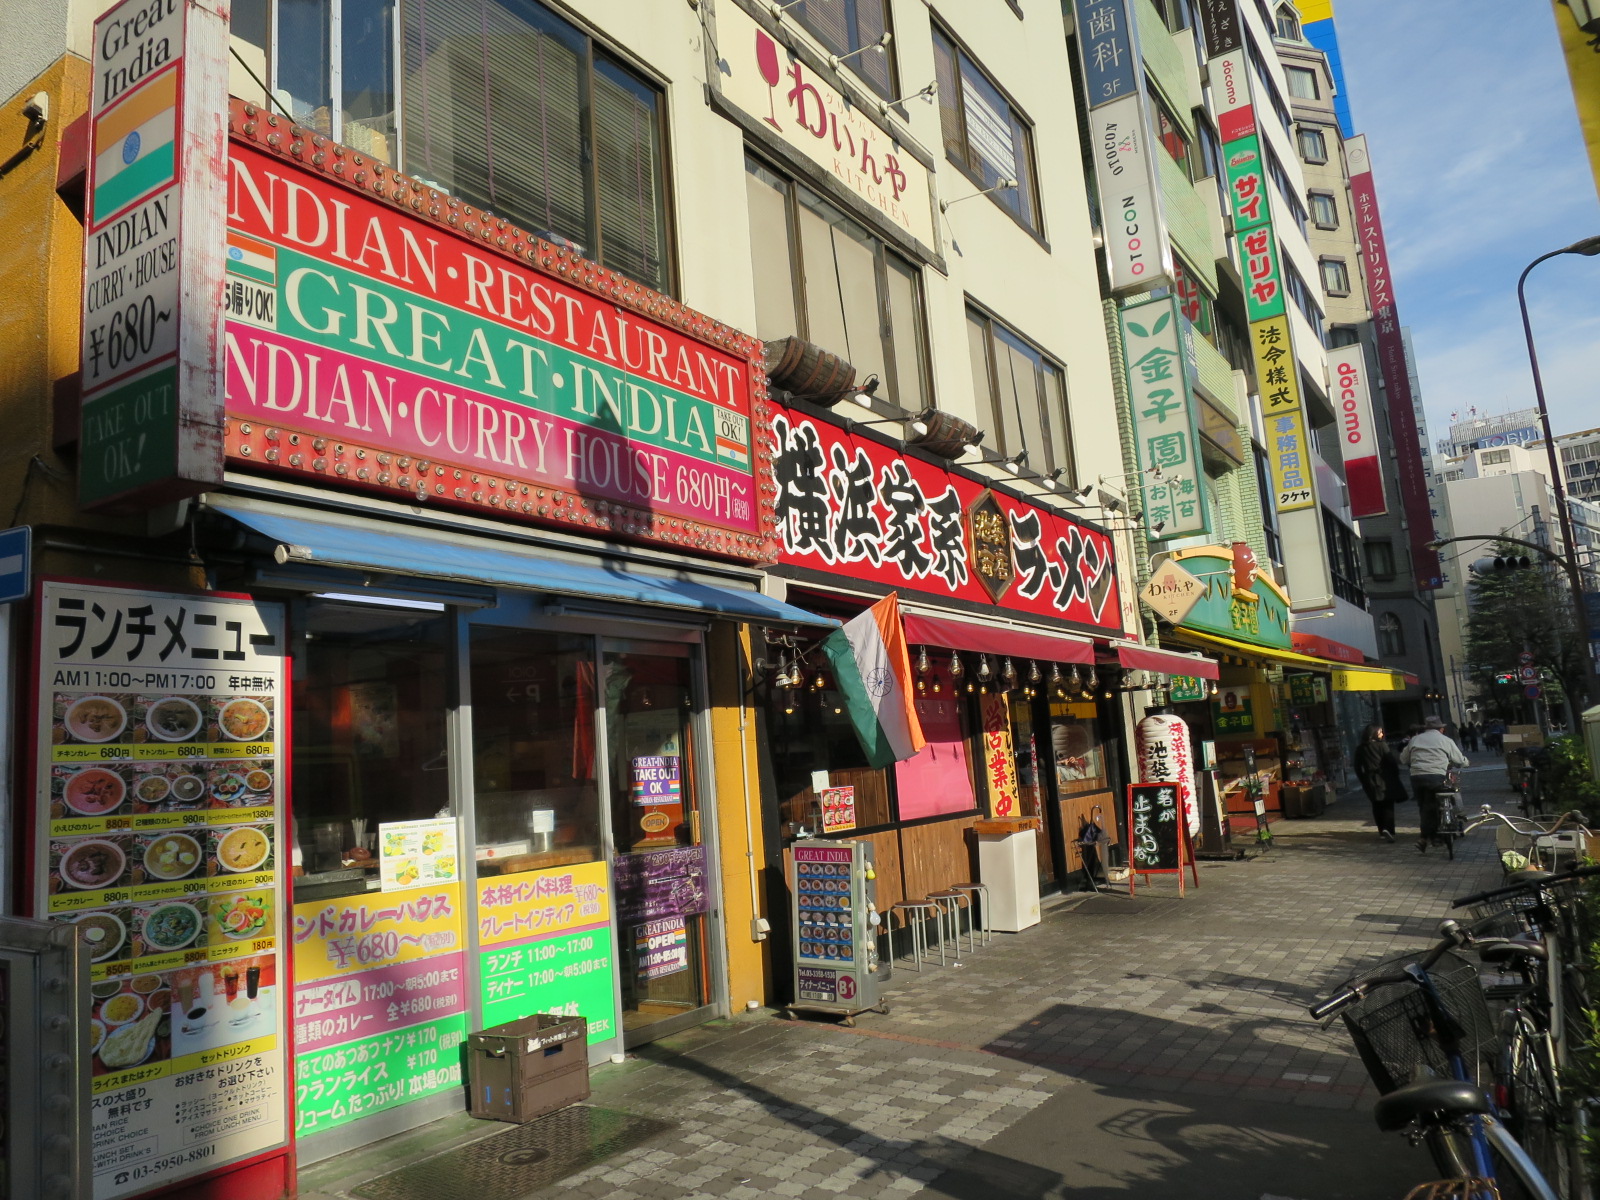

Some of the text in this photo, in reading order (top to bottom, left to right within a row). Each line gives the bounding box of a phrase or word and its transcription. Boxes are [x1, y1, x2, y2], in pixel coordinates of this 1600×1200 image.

[102, 0, 177, 60] Great
[1085, 0, 1123, 72] 歯科
[101, 34, 171, 107] India
[1103, 78, 1121, 97] 3F
[1222, 60, 1236, 105] docomo
[786, 60, 907, 202] わいんや
[1105, 123, 1124, 176] OTOCON
[833, 158, 910, 228] KITCHEN
[96, 195, 170, 269] INDIAN
[1121, 195, 1145, 275] OTOCON
[1235, 174, 1277, 304] サイゼリヤ
[229, 156, 740, 407] NDIAN RESTAURANT
[225, 281, 274, 323] ち帰りOK!
[285, 267, 714, 455] GREAT INDIA
[225, 332, 396, 438] NDIAN
[84, 383, 172, 447] TAKE OUT
[715, 408, 744, 427] TAKE OUT
[1130, 346, 1187, 469] 金子園
[1337, 362, 1362, 444] docomo
[721, 421, 741, 442] OK!
[1481, 429, 1531, 449] TOBU
[102, 434, 146, 484] OK!
[1274, 414, 1304, 489] 事務用品
[1280, 490, 1310, 504] タケヤ
[771, 414, 1114, 623] 横浜家系 ラーメン
[1148, 580, 1194, 597] わいんや
[55, 597, 276, 663] ランチメニュー
[1168, 609, 1179, 617] 2F
[228, 675, 275, 692] 年中無休
[245, 745, 270, 755] 680円
[1147, 740, 1171, 782] 池袋
[633, 767, 677, 781] TAKE OUT
[649, 781, 663, 794] OK
[798, 850, 849, 862] GREAT INDIA
[481, 874, 573, 908] 本格インド料理
[294, 894, 453, 943] ンドカレーハウス
[479, 903, 575, 938] グレートインディア
[211, 940, 273, 957] ミニサラダ 180円
[648, 933, 676, 949] OPEN
[486, 949, 523, 973] ランチ
[296, 984, 358, 1015] ナータイム
[486, 976, 524, 999] ディナー
[799, 979, 836, 991] ディナーメニュー
[295, 1013, 374, 1046] 種類のカレー
[586, 1018, 610, 1036] EEK
[200, 1044, 251, 1064] セットドリンク
[297, 1034, 405, 1081] たてのあつあつナン
[175, 1056, 262, 1088] お好きなドリンクを
[218, 1066, 275, 1089] お選び下さい
[297, 1061, 389, 1106] フランライス
[408, 1063, 462, 1096] 本場の味
[92, 1087, 147, 1110] スの大盛り
[108, 1098, 154, 1120] 無料です
[93, 1144, 135, 1162] UNCH SET
[132, 1144, 216, 1181] 03-5950-8801
